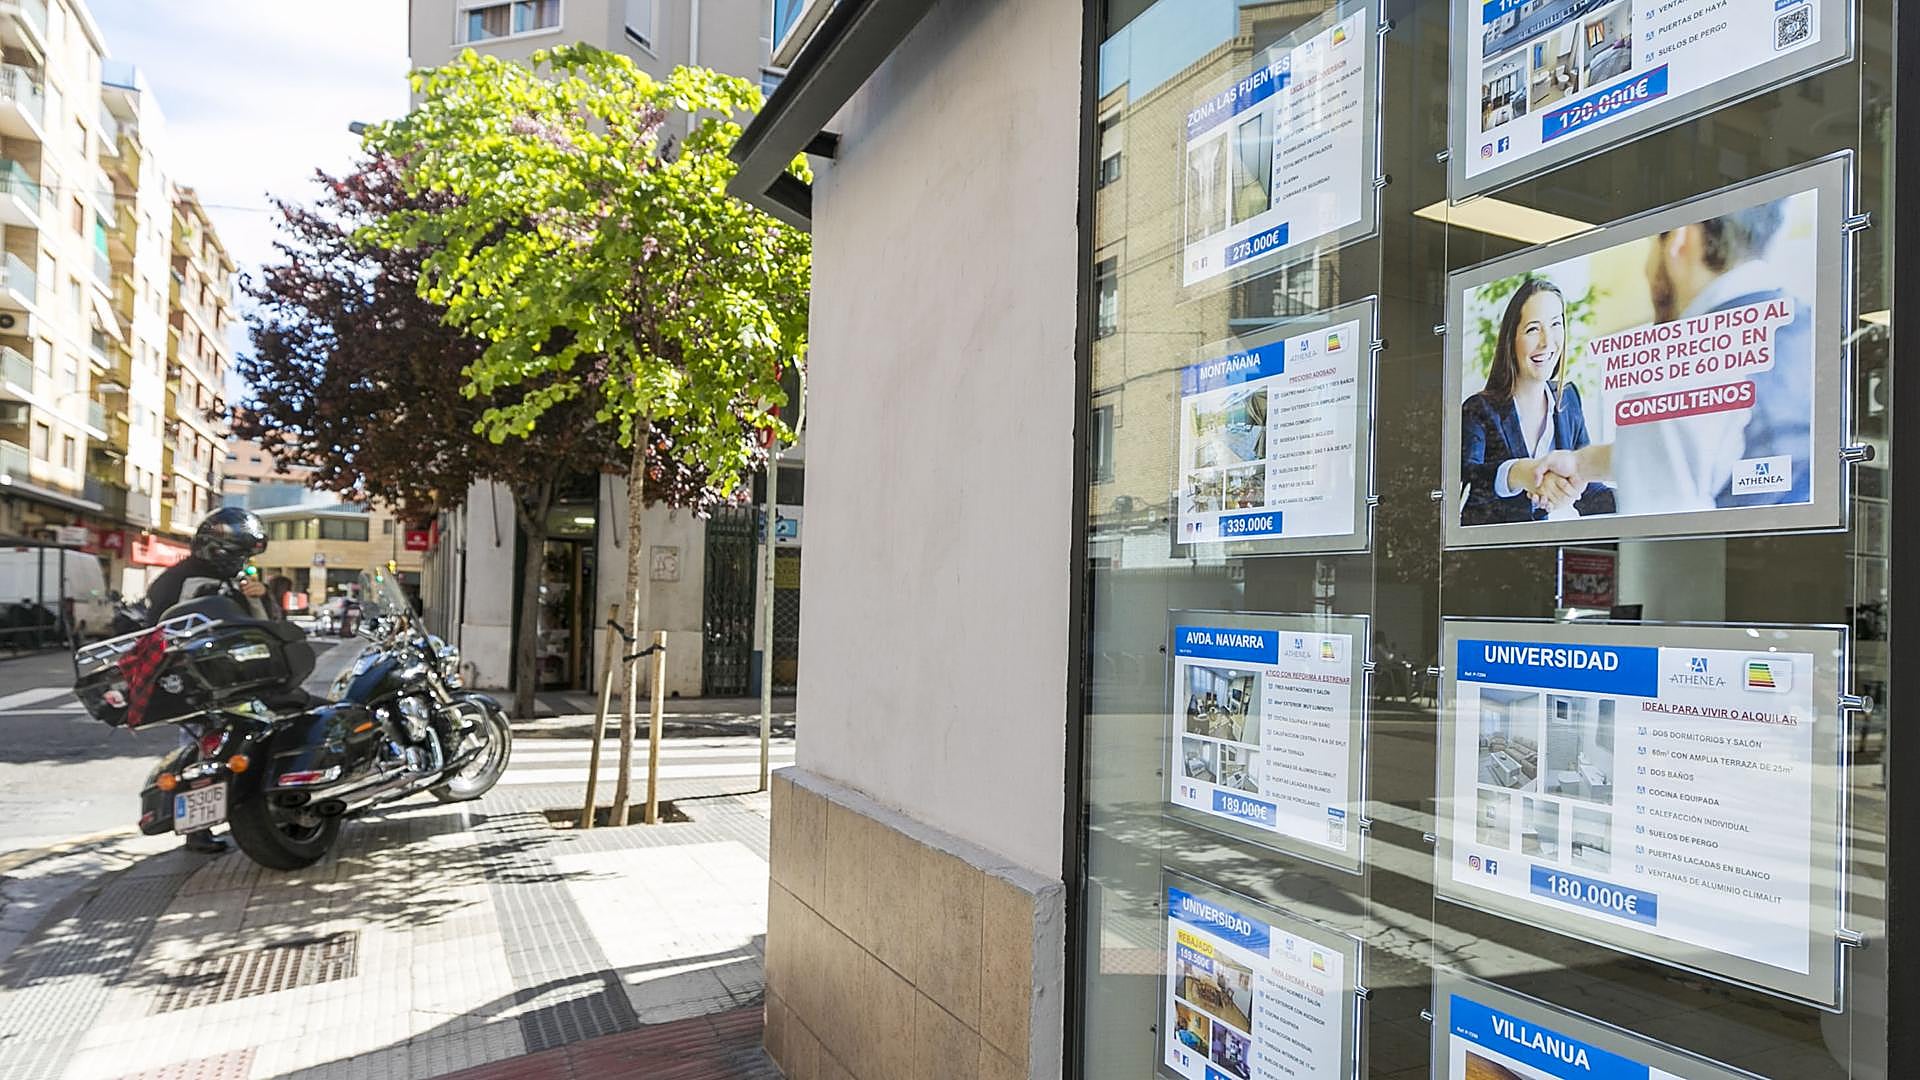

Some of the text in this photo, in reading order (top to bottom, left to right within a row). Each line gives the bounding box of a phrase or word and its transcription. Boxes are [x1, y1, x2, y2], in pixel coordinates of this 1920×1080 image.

[1658, 0, 1727, 34] PUERTAS DE HAYA
[1658, 22, 1727, 56] SUELOS DE PERGO
[1187, 102, 1215, 127] ZONA
[1216, 87, 1237, 110] LAS
[1239, 56, 1290, 97] FUENTES
[1560, 77, 1649, 129] 120.000€
[1233, 230, 1279, 260] 273.000€
[1590, 301, 1789, 355] VENDEMOS TU PISO AL
[1606, 326, 1767, 371] MEJOR PRECIO EN
[1200, 352, 1262, 380] MONTAÑANA
[1604, 347, 1770, 391] MENOS DE 60 DIAS
[1617, 383, 1752, 420] CONSULTENOS
[1738, 474, 1785, 486] ATHENEA
[1227, 516, 1273, 533] 339.000€
[1186, 631, 1264, 649] AVDA. NAVARRA
[1484, 644, 1619, 671] UNIVERSIDAD
[1323, 675, 1350, 684] ESTRENAR
[1669, 674, 1727, 687] ATHENEA
[1642, 701, 1798, 726] IDEAL PARA VIVIR O ALQUILAR
[1652, 729, 1668, 738] DOS
[1669, 731, 1725, 744] DORMITORIOS
[1733, 738, 1762, 749] SALÓN
[1650, 768, 1694, 781] DOS BAÑOS
[1670, 751, 1687, 760] CON
[1688, 753, 1719, 764] AMPLIA
[1720, 758, 1758, 769] TERRAZA
[1759, 763, 1771, 772] DE
[1222, 796, 1267, 820] 189.000€
[1649, 788, 1720, 806] COCINA EQUIPADA
[1649, 808, 1750, 833] CALEFACCIÓN INDIVIDUAL
[1649, 829, 1719, 849] SUELOS DE PERGO
[1648, 848, 1770, 880] PUERTAS LACADAS EN BLANCO
[1548, 875, 1637, 915] 180.000€
[1648, 868, 1783, 904] VENTANAS DE ALUMINIO CLIMALIT
[1182, 896, 1252, 937] UNIVERSIDAD
[1491, 1014, 1591, 1071] VILLANUA
